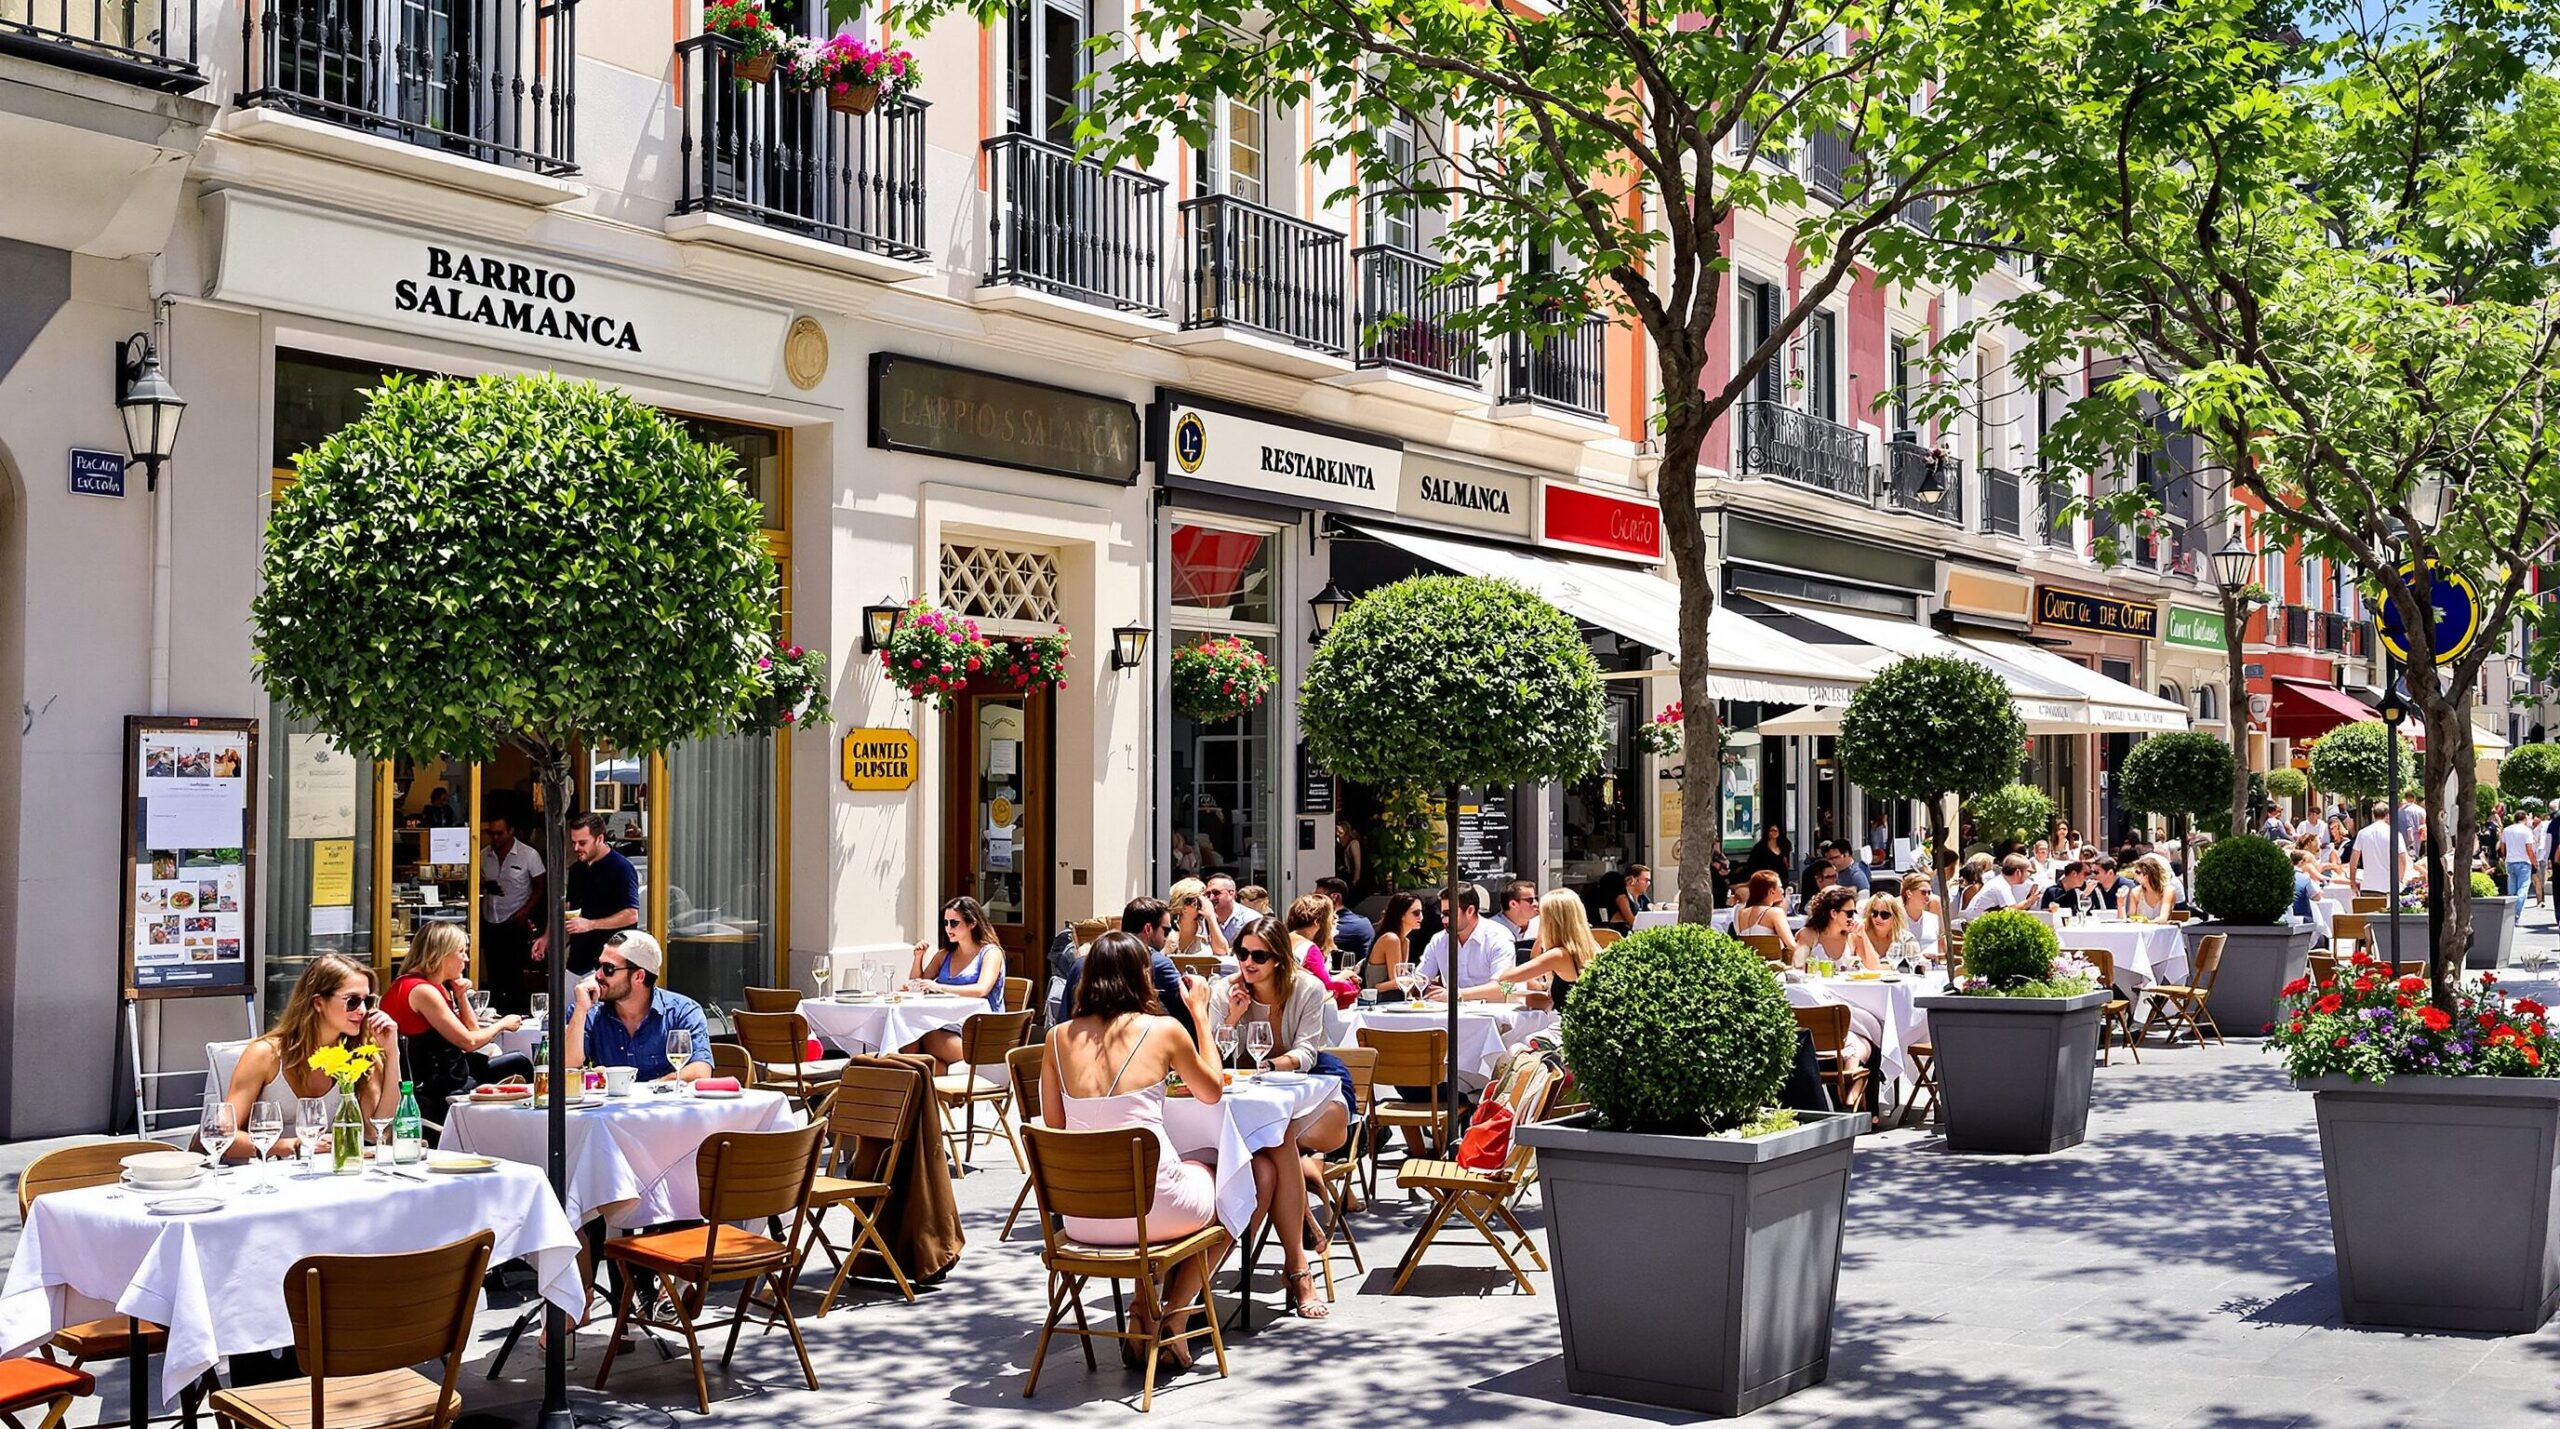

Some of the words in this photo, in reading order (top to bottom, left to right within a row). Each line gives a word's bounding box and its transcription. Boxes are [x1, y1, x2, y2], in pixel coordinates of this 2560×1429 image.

[427, 246, 576, 303] BARRIO
[395, 279, 642, 352] SALAMANCA
[1421, 475, 1510, 514] SALMANCA
